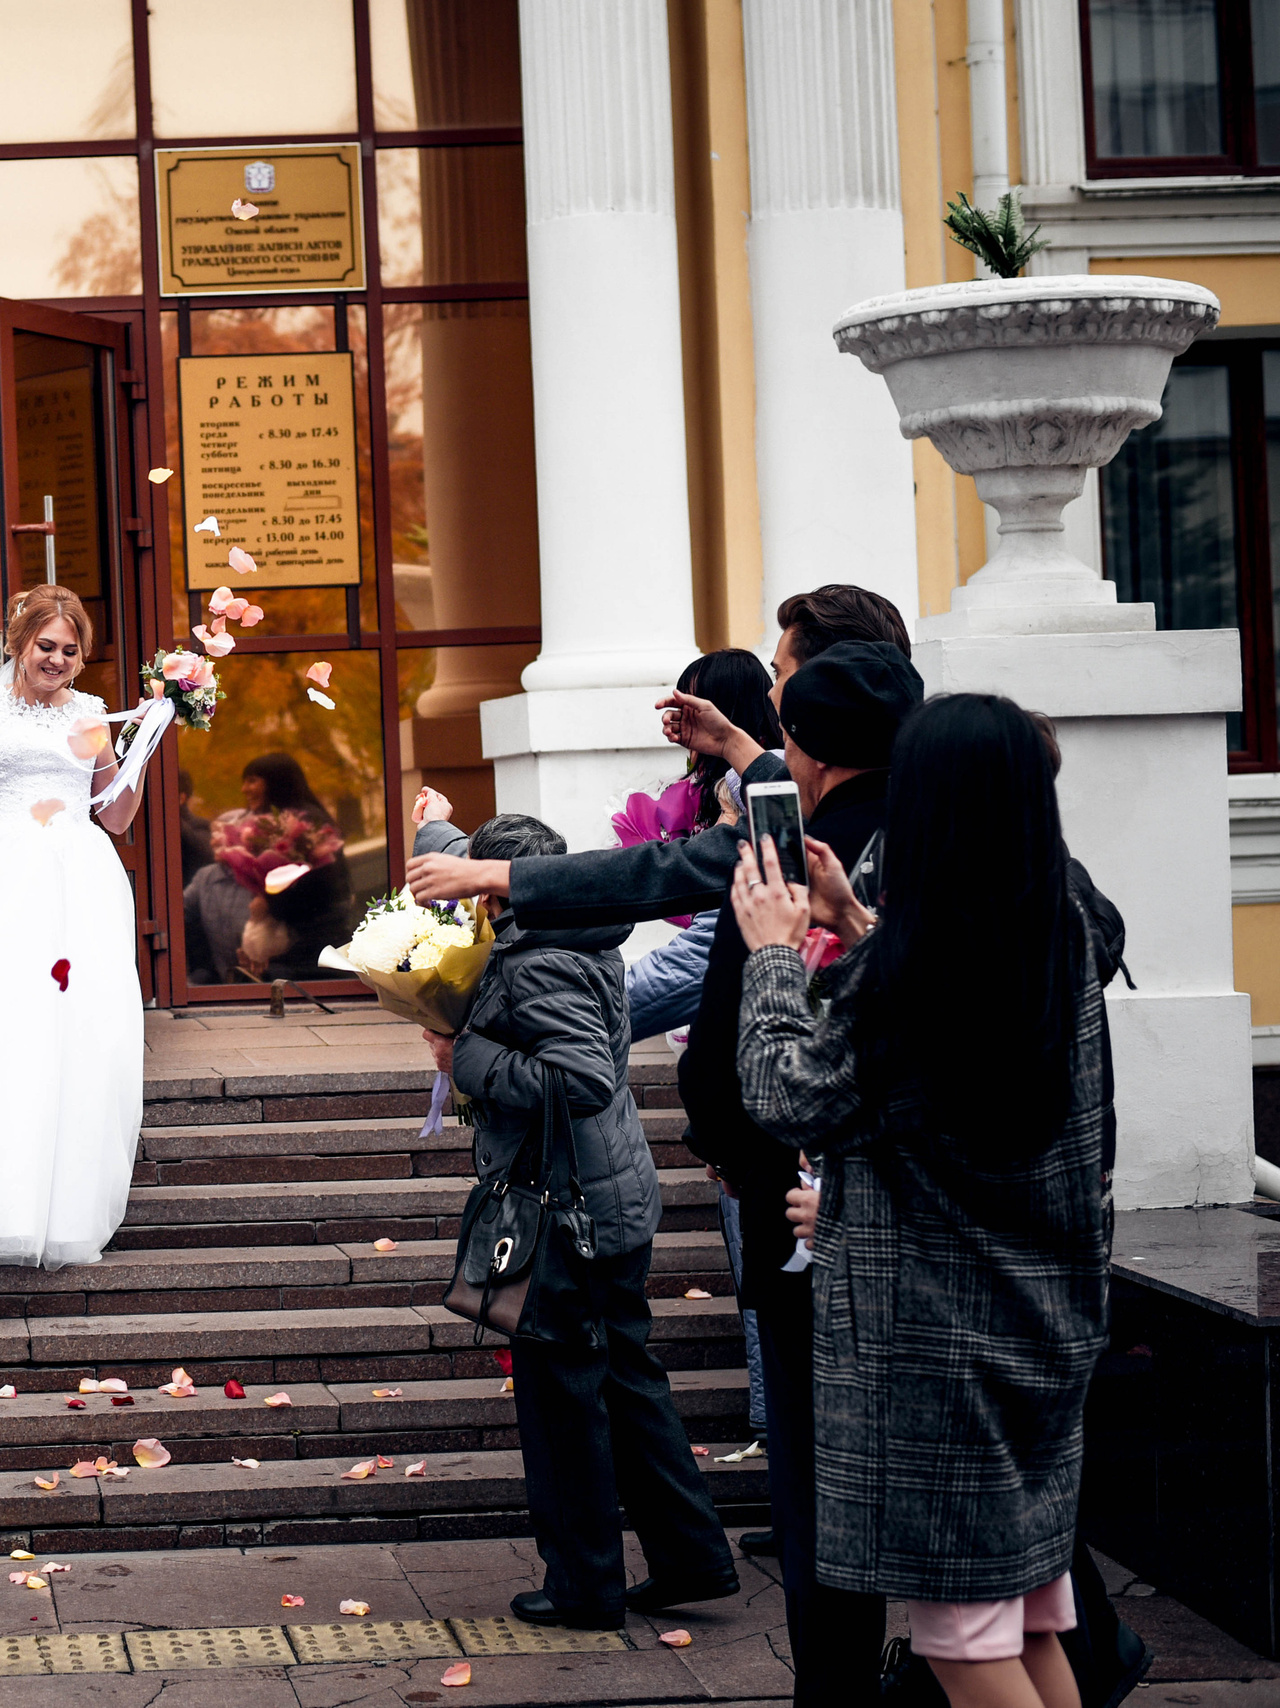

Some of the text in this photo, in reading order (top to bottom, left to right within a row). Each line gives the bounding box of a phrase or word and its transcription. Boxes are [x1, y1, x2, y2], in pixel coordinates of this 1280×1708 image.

[225, 225, 299, 235] Омской области
[181, 240, 343, 255] УПРАВЛЕНИЕ ЗАПИСИ АКТОВ
[182, 253, 340, 267] ГРАЖДАНСКОГО СОСТОЯНИЯ
[216, 374, 321, 389] РЕЖИМ
[209, 393, 329, 409] РАБОТЫ
[200, 421, 240, 430] вторник
[200, 431, 228, 440] среда
[268, 428, 291, 439] 8.30
[295, 431, 307, 439] до
[311, 427, 339, 437] 17.45
[200, 441, 238, 449] четверг
[201, 450, 238, 460] суббота
[201, 465, 242, 474] пятница
[269, 460, 292, 470] 8.30
[296, 462, 308, 470] до
[312, 458, 340, 469] 16.30
[202, 478, 337, 490] воскресенье выходные
[202, 488, 322, 499] понедельник дни
[203, 507, 266, 515] понедельник
[271, 515, 295, 525] 8.30
[315, 514, 342, 524] 17.45
[203, 537, 246, 546] перерыв
[266, 532, 295, 542] 13.00
[315, 530, 344, 541] 14.00
